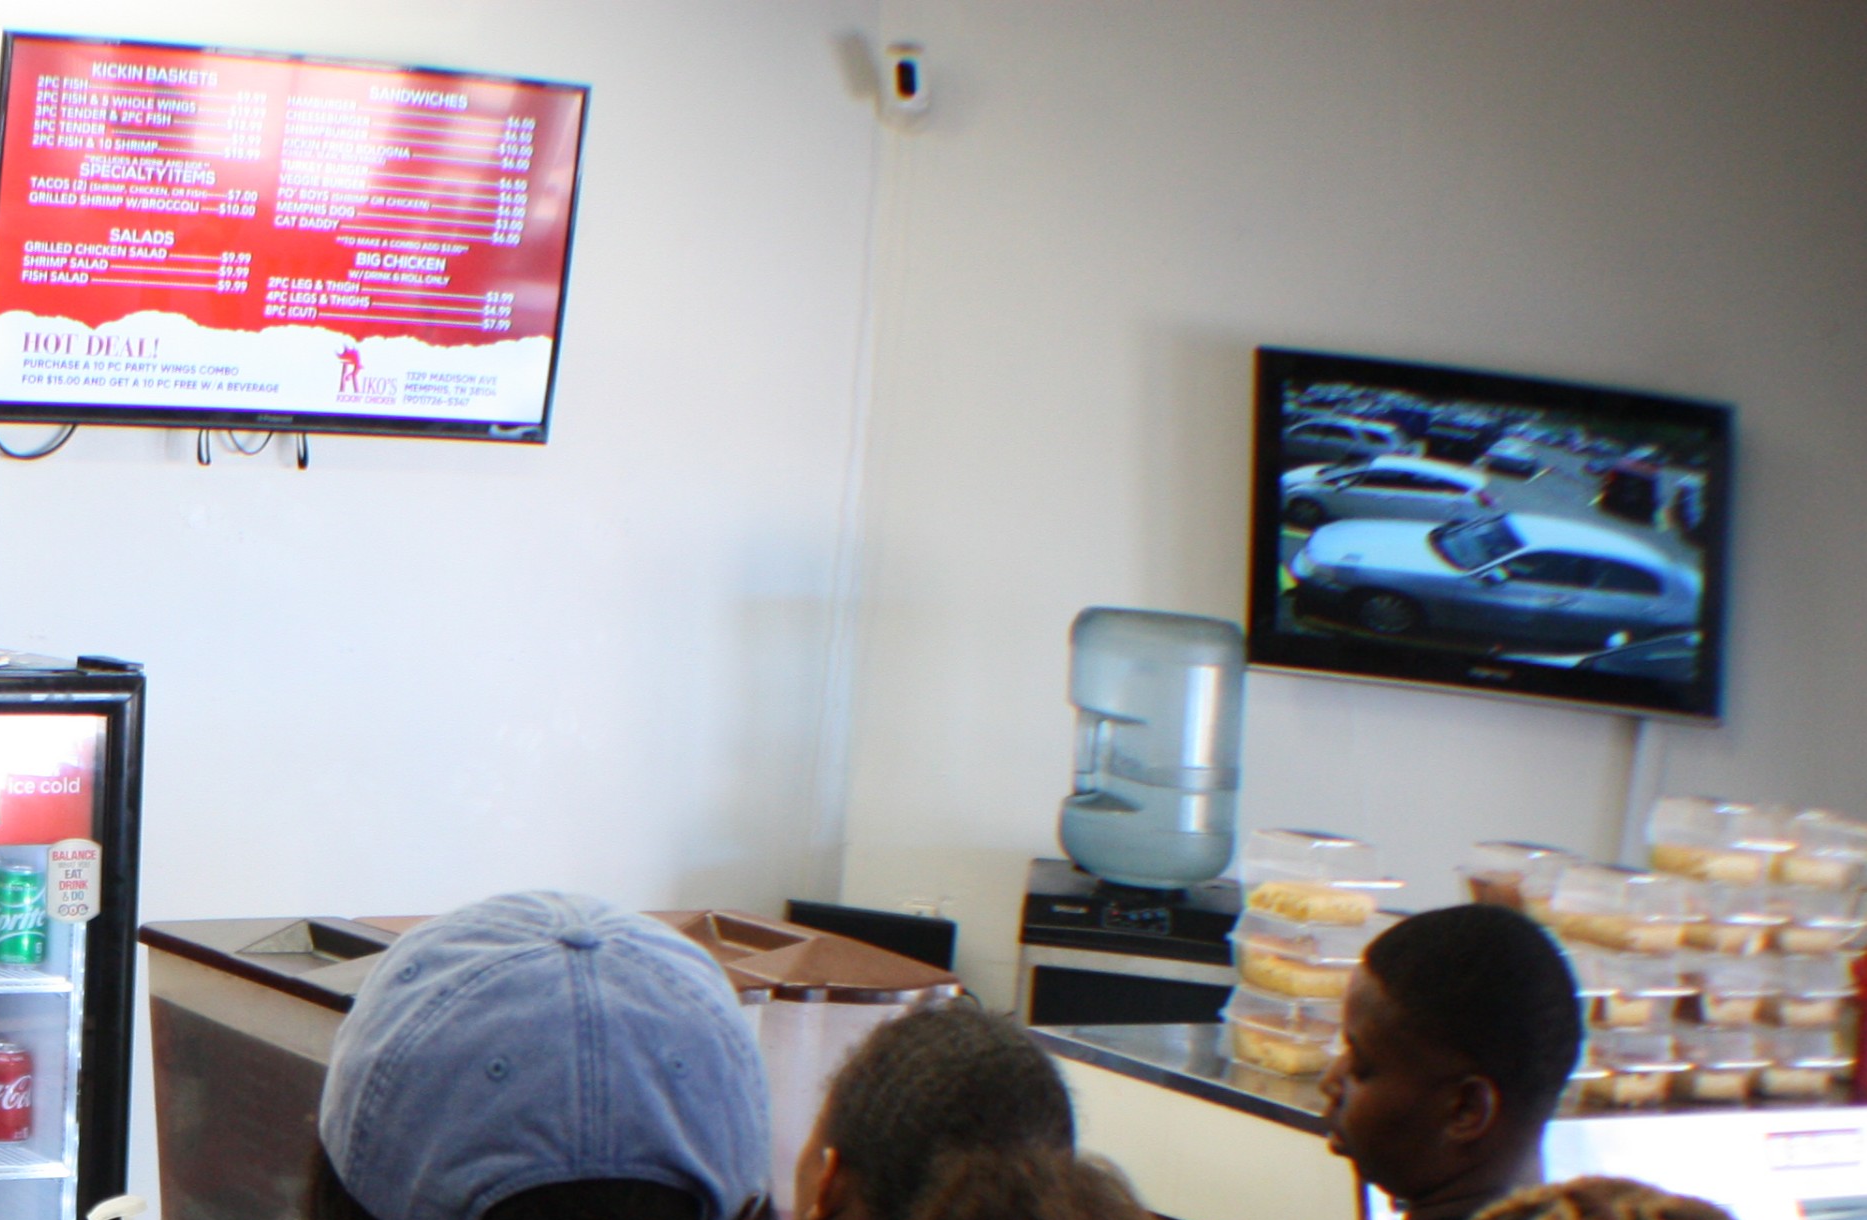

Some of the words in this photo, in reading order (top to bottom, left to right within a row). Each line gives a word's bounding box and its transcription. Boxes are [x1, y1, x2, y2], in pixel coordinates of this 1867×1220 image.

[92, 62, 144, 82] KICKIN
[146, 65, 218, 86] BASKETS
[38, 76, 59, 89] 2PC
[63, 78, 89, 91] FISH
[62, 92, 86, 105] FISH
[112, 96, 154, 109] WHOLE
[157, 99, 196, 112] WINGS
[370, 85, 468, 110] SANDWICHES
[61, 107, 105, 121] TENDER
[146, 113, 171, 126] FISH
[59, 123, 105, 136] TENDER
[57, 136, 83, 149] FISH
[114, 140, 158, 153] SHRIMP
[80, 162, 168, 182] SPECIALTY
[170, 168, 215, 185] ITEMS
[31, 177, 70, 191] TACOS
[227, 189, 258, 201] $7.00
[300, 189, 329, 202] BOYS
[30, 192, 77, 206] GRILLED
[80, 195, 123, 209] SHRIMP
[126, 197, 199, 213] W/BROCCOLI
[219, 202, 256, 216] $10.00
[276, 202, 327, 217] MEMPHIS
[329, 206, 355, 219] DOG
[274, 215, 297, 229] CAT
[299, 217, 340, 232] DADDY
[110, 227, 175, 246] SALADS
[24, 241, 72, 256] GRILLED
[75, 244, 126, 258] CHICKEN
[129, 246, 167, 260] SALAD
[221, 251, 251, 264] $9.99
[23, 256, 67, 269] SHRIMP
[70, 258, 108, 271] SALAD
[218, 265, 249, 278] $9.99
[355, 252, 380, 268] BIG
[382, 254, 446, 272] CHICKEN
[22, 270, 48, 283] FISH
[50, 272, 89, 285] SALAD
[217, 280, 248, 292] $9.99
[268, 278, 288, 290] 2PC
[291, 279, 313, 291] LEG
[327, 281, 359, 295] THIGH
[266, 292, 287, 304] 4PC
[289, 294, 314, 306] LEGS
[331, 296, 370, 310] THIGHS
[23, 332, 78, 356] HOT
[86, 334, 159, 358] DEAL!
[23, 359, 80, 371] PURCHASE
[125, 363, 157, 373] PARTY
[161, 364, 196, 375] WINGS
[199, 365, 239, 376] COMBO
[338, 356, 398, 393] RIKO'S
[22, 375, 44, 385] FOR
[47, 376, 80, 386] $15.00
[83, 377, 106, 387] AND
[109, 378, 130, 388] GET
[174, 380, 197, 390] FREE
[227, 382, 279, 393] BEVERAGE
[430, 373, 477, 384] MADISON
[480, 375, 497, 385] AVE
[404, 384, 451, 395] MEMPHIS,
[7, 778, 36, 795] ice
[40, 777, 81, 794] cold
[52, 850, 97, 861] BALANCE
[65, 869, 82, 879] EAT
[58, 880, 89, 890] DRINK
[71, 891, 84, 900] DO
